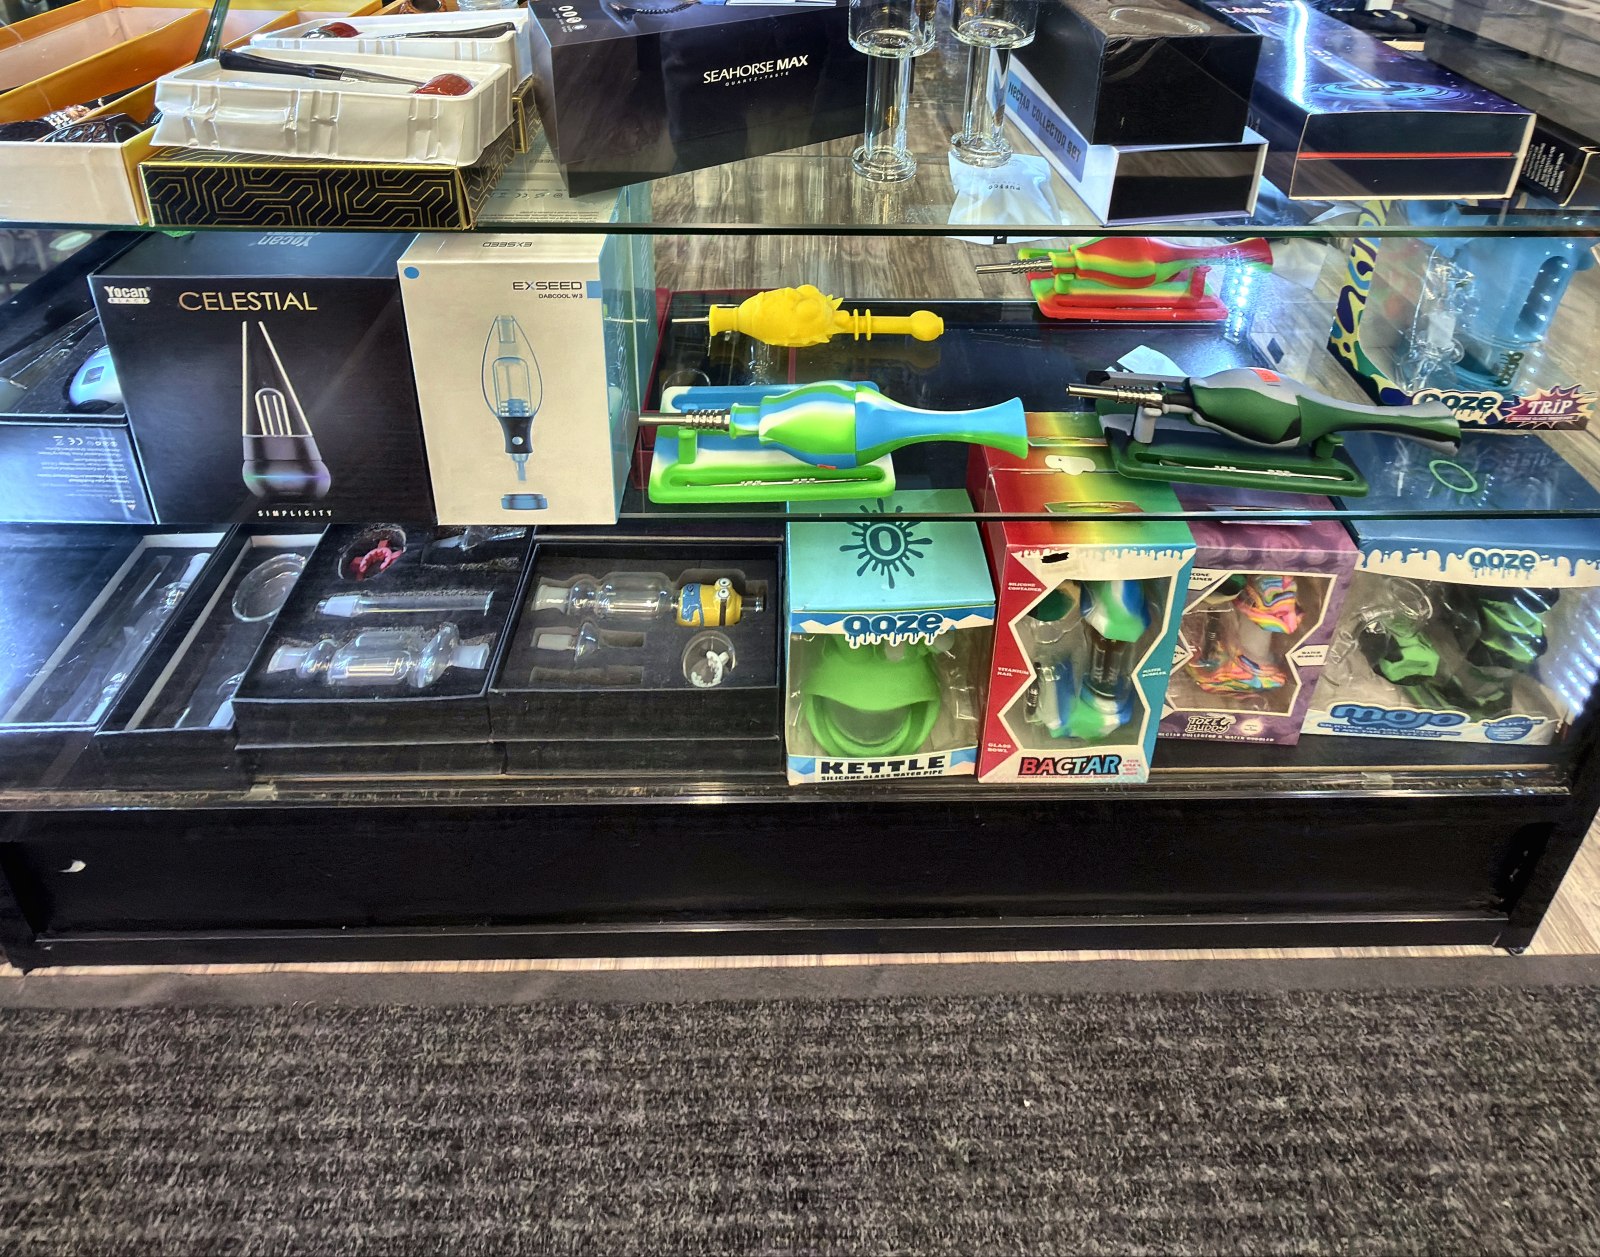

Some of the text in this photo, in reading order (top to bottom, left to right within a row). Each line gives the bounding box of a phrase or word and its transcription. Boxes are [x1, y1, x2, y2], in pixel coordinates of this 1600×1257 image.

[703, 54, 809, 84] SEAHORSE MAX
[512, 281, 583, 291] EXSEED
[178, 291, 318, 311] CELESTIAL
[1527, 399, 1574, 415] TRIP
[257, 509, 332, 517] SIMPLICITY
[1468, 551, 1536, 574] ooze
[843, 613, 943, 641] ooze
[1330, 704, 1466, 729] mojo
[1187, 724, 1228, 733] BUDDY
[820, 755, 946, 775] KETTLE
[1018, 754, 1122, 776] BACTAR
